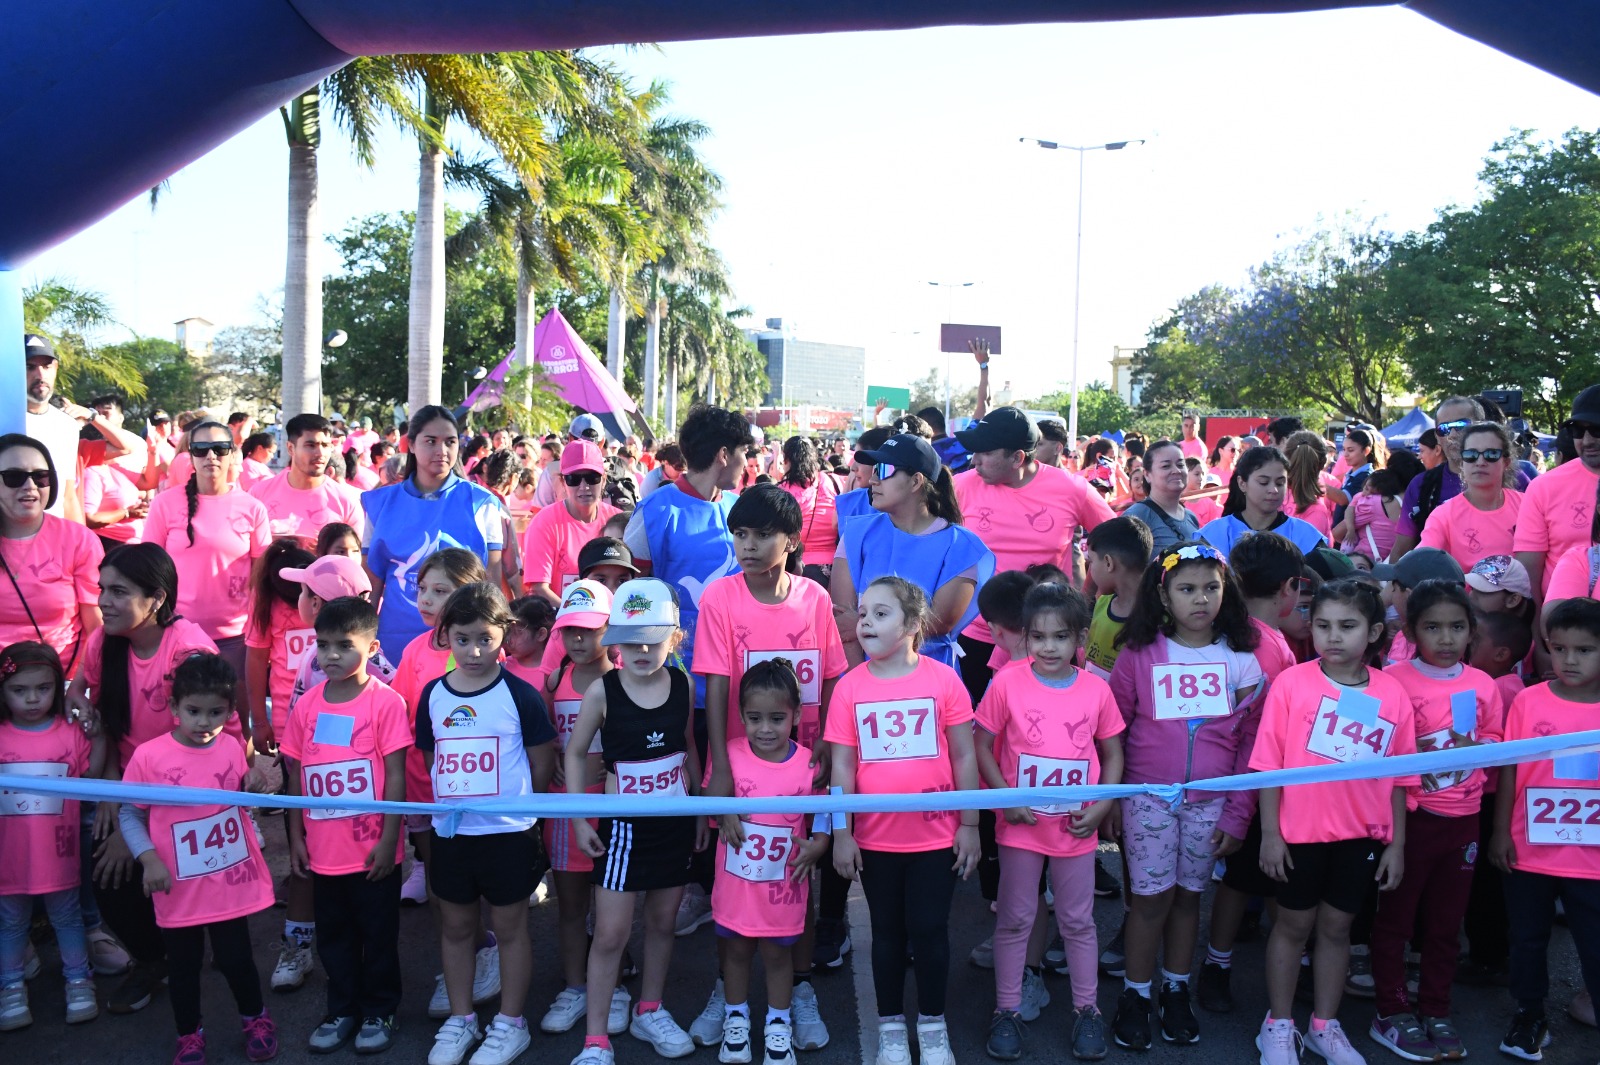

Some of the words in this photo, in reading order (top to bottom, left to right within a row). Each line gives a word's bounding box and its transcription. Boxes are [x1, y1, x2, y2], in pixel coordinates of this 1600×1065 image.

[289, 636, 317, 655] 05
[1158, 673, 1221, 698] 183
[558, 714, 578, 733] 25
[862, 708, 929, 738] 137
[1323, 710, 1384, 754] 144
[438, 752, 494, 774] 2560
[1024, 765, 1083, 787] 148
[309, 767, 368, 797] 065
[622, 766, 680, 794] 2559
[1533, 798, 1600, 824] 222
[181, 817, 239, 855] 149
[733, 834, 788, 862] 35
